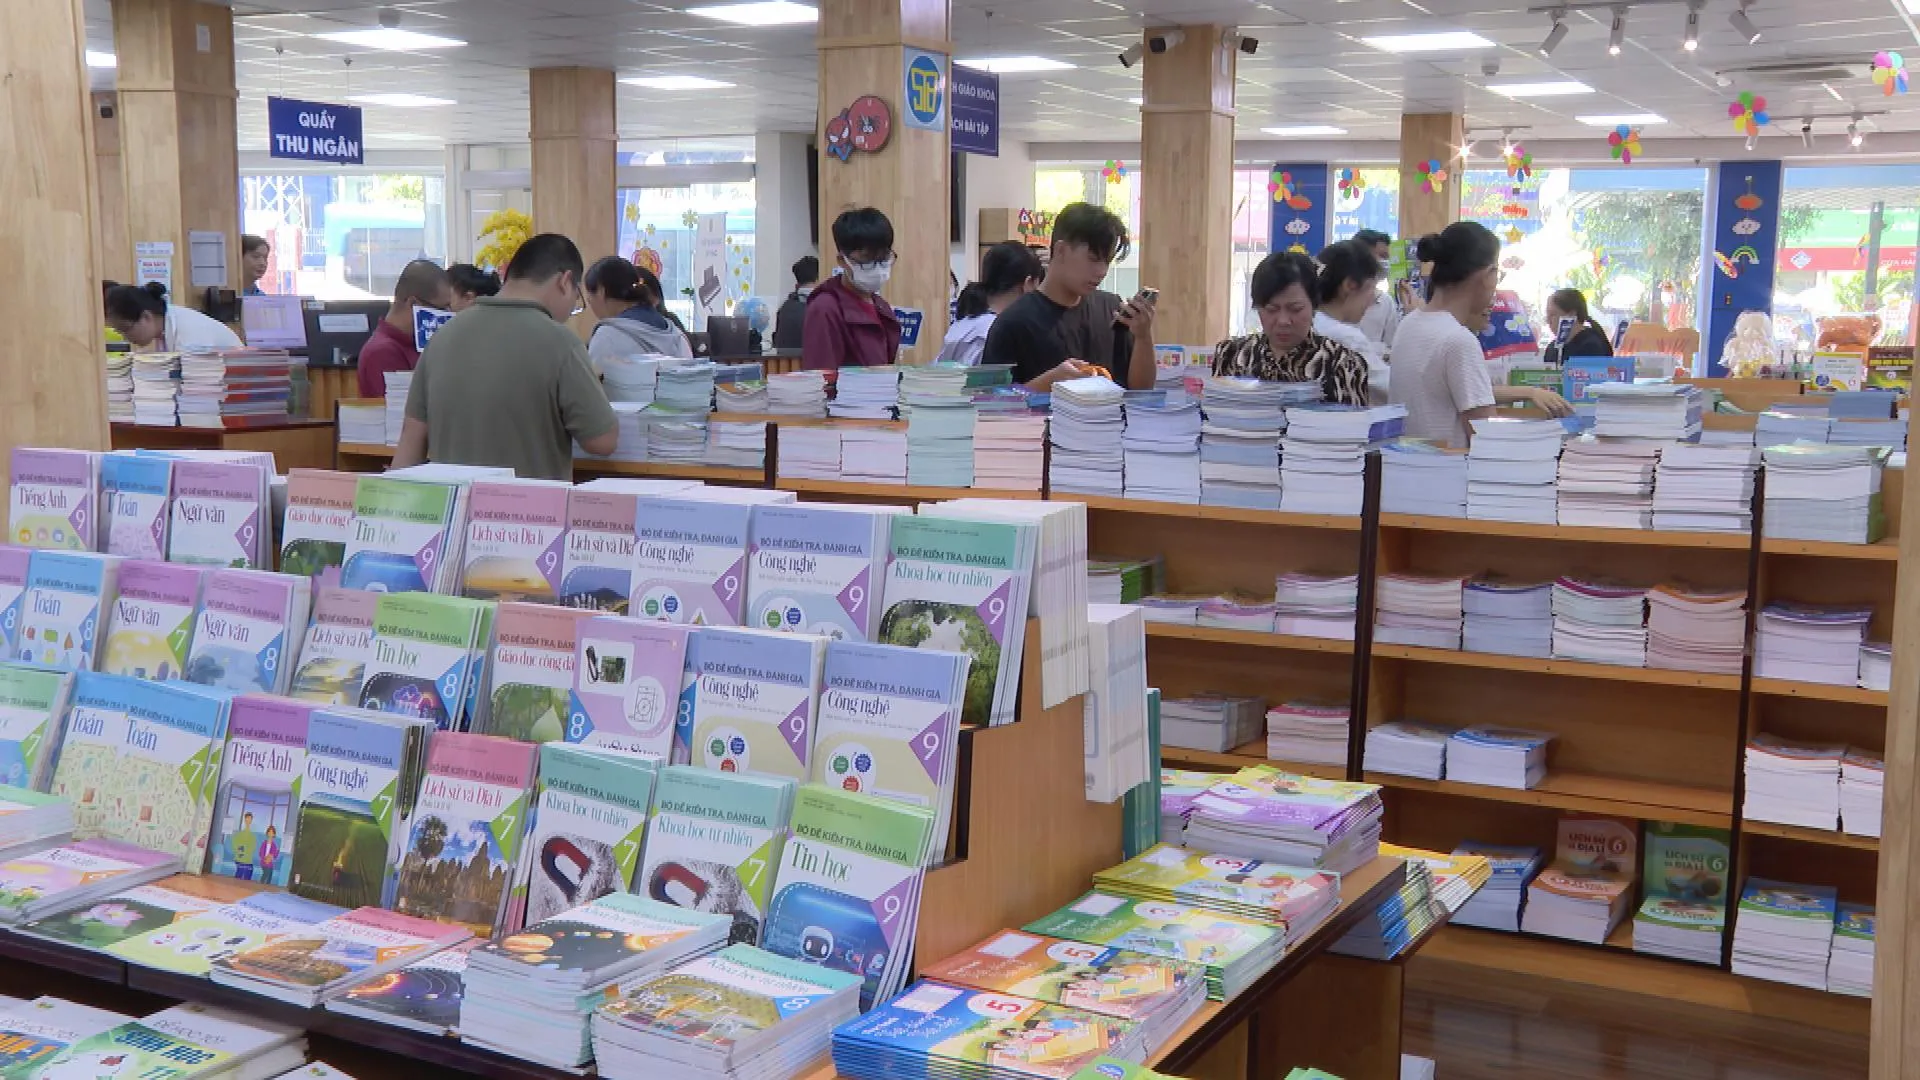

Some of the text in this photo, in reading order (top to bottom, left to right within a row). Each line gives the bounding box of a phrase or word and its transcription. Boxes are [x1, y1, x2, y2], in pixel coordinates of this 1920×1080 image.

[958, 82, 976, 97] GIÁO
[976, 87, 996, 103] KHOA
[976, 121, 990, 136] TẬP
[275, 133, 359, 158] THU NGÂN
[19, 486, 67, 511] Tiếng Anh
[117, 492, 137, 517] Toán
[76, 510, 85, 530] 9
[179, 500, 225, 524] Ngữ văn
[308, 510, 323, 525] dục
[325, 512, 346, 529] công
[156, 518, 163, 538] 9
[243, 526, 254, 546] 9
[355, 520, 400, 546] Tin học
[472, 524, 492, 544] Lịch
[494, 528, 506, 543] sử
[508, 530, 518, 543] và
[521, 528, 536, 546] Địa
[570, 533, 592, 552] Lịch
[593, 537, 604, 553] sử
[606, 540, 617, 555] và
[640, 542, 694, 565] Công nghệ
[421, 548, 434, 571] 9
[545, 552, 557, 575] 9
[759, 552, 816, 574] Công nghệ
[896, 562, 993, 588] Khoa học tự nhiên
[724, 575, 738, 601] 9
[849, 585, 864, 613] 9
[33, 590, 61, 617] Toán
[117, 601, 160, 626] Ngữ văn
[989, 597, 1005, 625] 9
[5, 608, 16, 629] 8
[84, 619, 93, 641] 8
[202, 613, 249, 642] Ngữ văn
[175, 629, 187, 651] 7
[312, 627, 333, 645] Lịch
[334, 629, 344, 645] sử
[346, 631, 357, 647] và
[264, 648, 277, 671] 8
[376, 639, 421, 669] Tin học
[498, 647, 575, 672] Giáo dục công dâ
[443, 674, 457, 698] 8
[702, 675, 759, 701] Công nghệ
[828, 690, 890, 718] Công nghệ
[72, 709, 104, 737] Toán
[125, 718, 158, 751] Toán
[571, 712, 585, 739] 8
[790, 715, 805, 743] 9
[25, 734, 41, 757] 7
[232, 742, 292, 773] Tiếng Anh
[923, 731, 939, 761] 9
[189, 760, 203, 784] 7
[204, 764, 217, 786] 7
[307, 758, 369, 792] Công nghệ
[425, 777, 503, 808] Lịch sử và Địa lí
[379, 795, 392, 821] 7
[546, 792, 628, 829] Khoa học tự nhiên
[661, 799, 673, 809] BỘ
[674, 801, 685, 811] ĐỀ
[686, 803, 706, 815] KIỂM
[708, 807, 725, 819] TRA,
[500, 814, 516, 841] 7
[658, 816, 753, 848] Khoa học tự nhiên
[796, 823, 809, 834] BỘ
[810, 826, 822, 837] ĐỀ
[822, 831, 845, 843] KIỂM
[845, 836, 863, 851] TRA,
[622, 839, 637, 867] 7
[1612, 837, 1622, 850] 6
[1665, 850, 1688, 861] LỊCH
[748, 857, 766, 887] 7
[792, 841, 852, 883] Tin học
[1674, 861, 1693, 871] ĐỊA
[1711, 856, 1722, 870] 6
[883, 895, 900, 923] 9
[1064, 947, 1097, 959] 5
[782, 997, 811, 1009] 8
[987, 1000, 1022, 1013] 5
